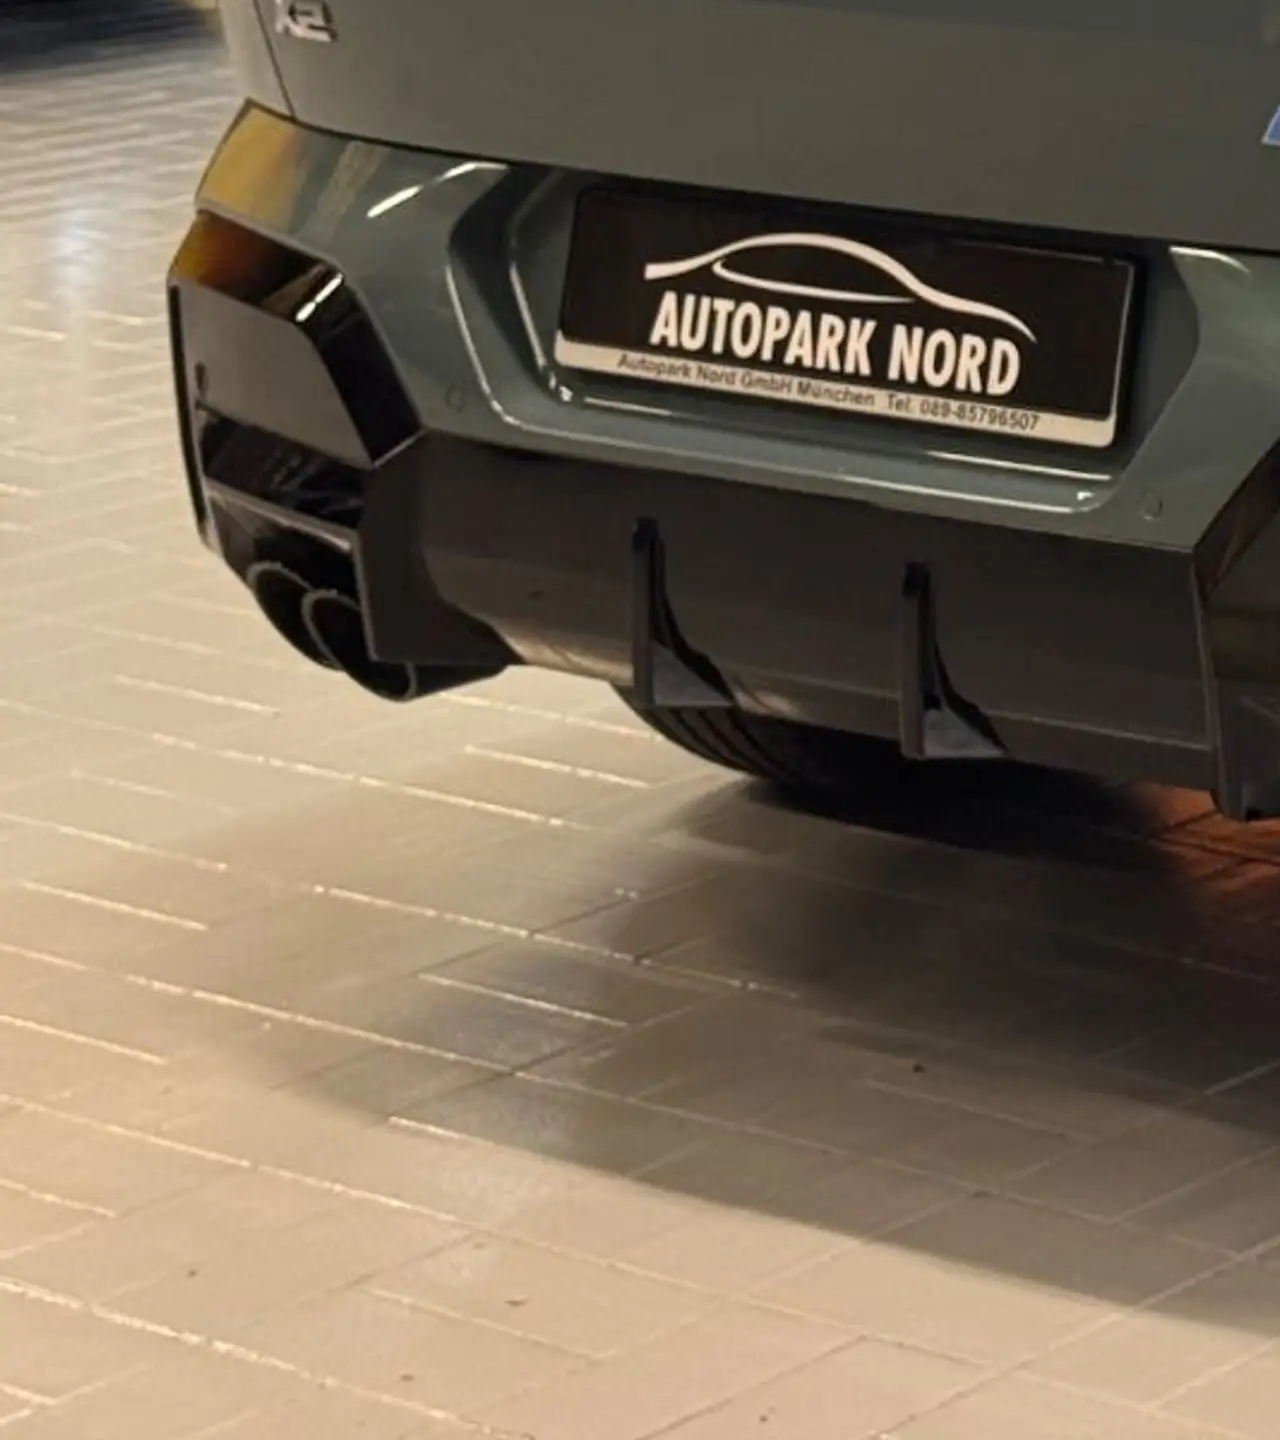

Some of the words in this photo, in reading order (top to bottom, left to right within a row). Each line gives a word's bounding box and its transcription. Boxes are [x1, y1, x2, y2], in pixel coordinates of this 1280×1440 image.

[616, 353, 691, 379] Autopark
[696, 366, 737, 386] Nord
[740, 372, 793, 394] GmbH
[797, 380, 876, 407] München
[649, 290, 877, 377] AUTOPARK
[888, 323, 1021, 397] NORD
